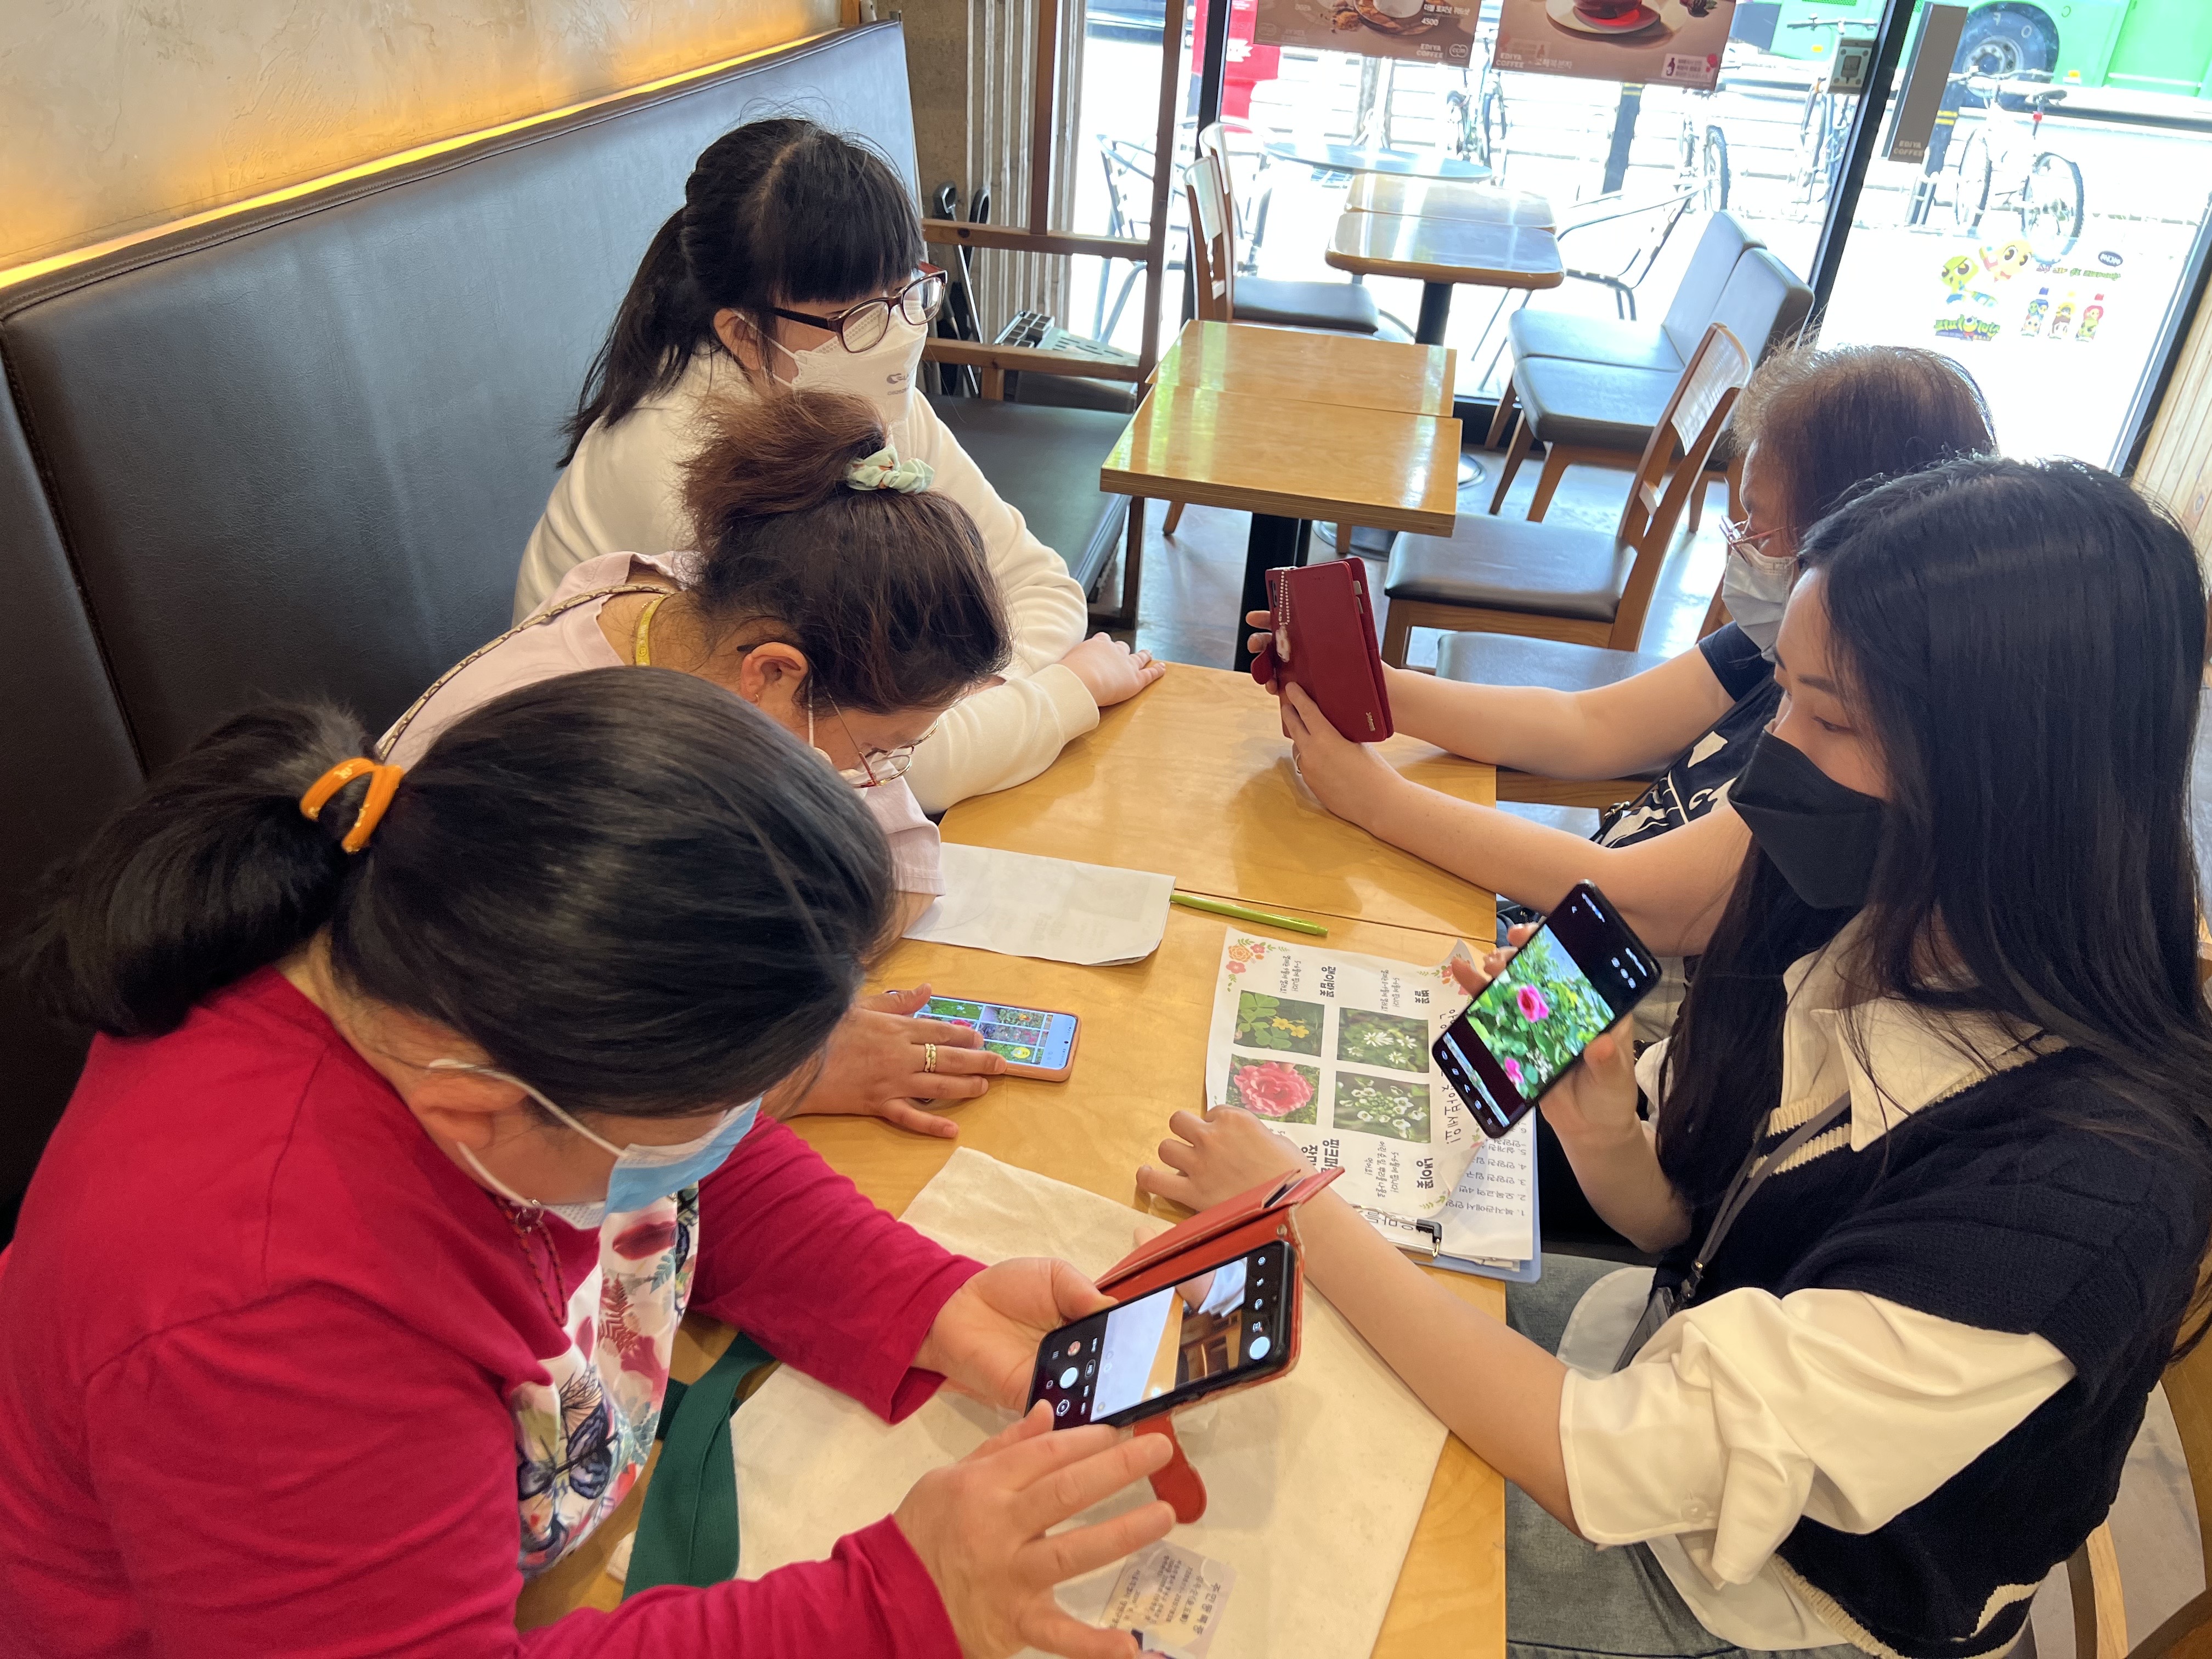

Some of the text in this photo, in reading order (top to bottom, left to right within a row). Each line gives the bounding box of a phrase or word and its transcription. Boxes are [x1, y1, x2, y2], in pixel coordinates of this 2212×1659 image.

[1416, 50, 1443, 58] COFFEE
[1496, 60, 1524, 68] COFFEE
[1899, 140, 1922, 148] EDIYA
[1893, 148, 1924, 156] COFFEE
[1319, 966, 1336, 997] 괭이밥꽃
[1414, 990, 1430, 1005] 별꽃
[1488, 1144, 1515, 1154] 실개천
[1488, 1158, 1515, 1170] 안양천
[1416, 1158, 1434, 1189] 냉이꽃
[1466, 1171, 1485, 1181] 입구
[1487, 1174, 1515, 1184] 안양천
[1459, 1185, 1475, 1194] 4번
[1477, 1188, 1515, 1200] 오목교역
[1466, 1203, 1514, 1216] 복지관에서
[1192, 1581, 1221, 1637] 주민등록증
